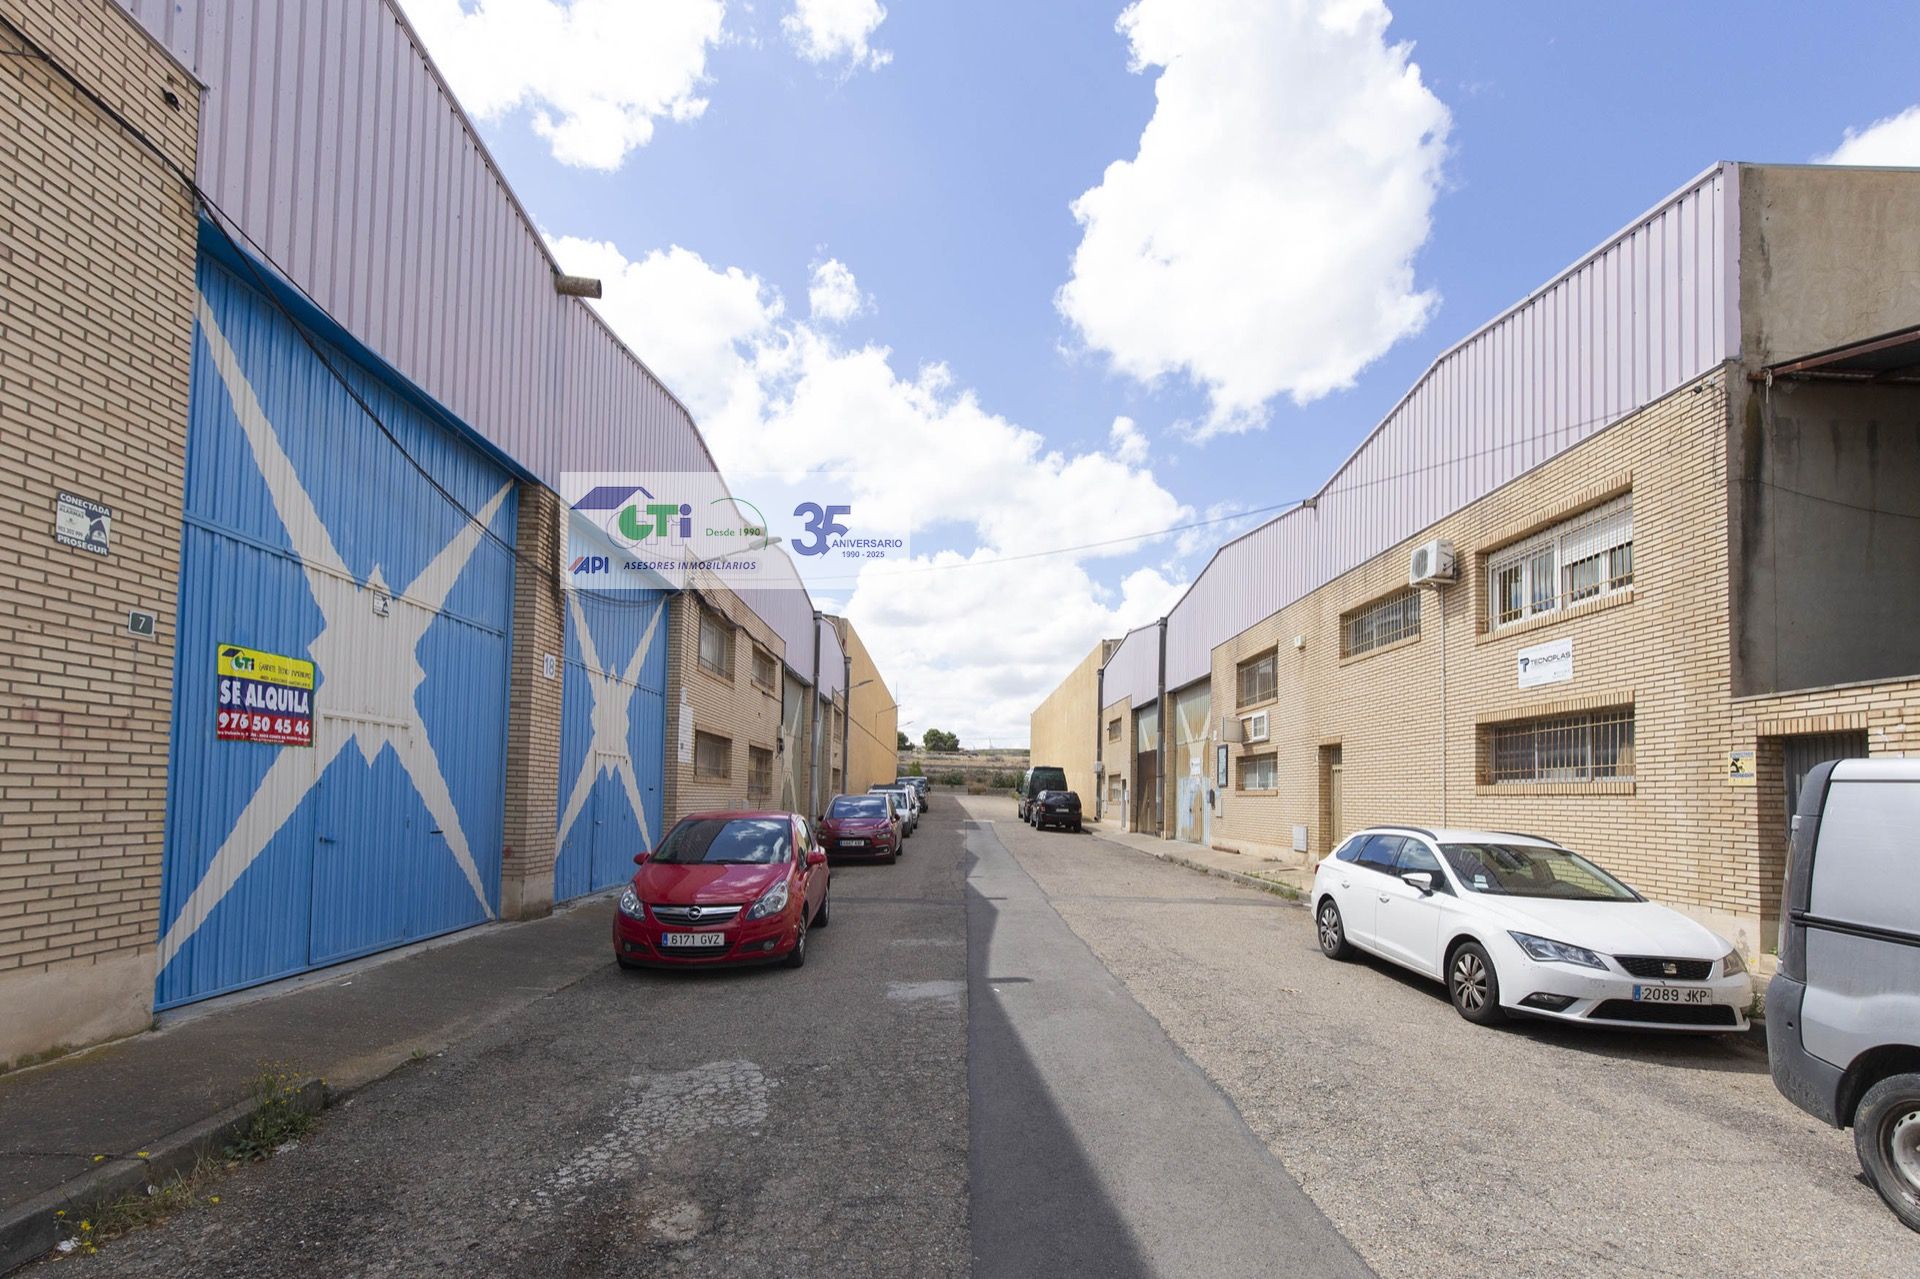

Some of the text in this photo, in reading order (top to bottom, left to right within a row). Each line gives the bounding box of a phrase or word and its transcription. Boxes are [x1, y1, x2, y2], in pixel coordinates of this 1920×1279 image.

[60, 493, 110, 516] CONECTADA
[57, 533, 108, 556] PROSEGUR
[139, 616, 146, 630] 7
[545, 656, 555, 676] 18
[1530, 651, 1571, 666] TECNOPLAS
[219, 679, 241, 705] SE
[245, 683, 309, 714] ALQUILA
[218, 712, 309, 736] 976 50 45 46
[671, 934, 720, 945] 6171 GVZ
[1643, 987, 1680, 1001] 2089
